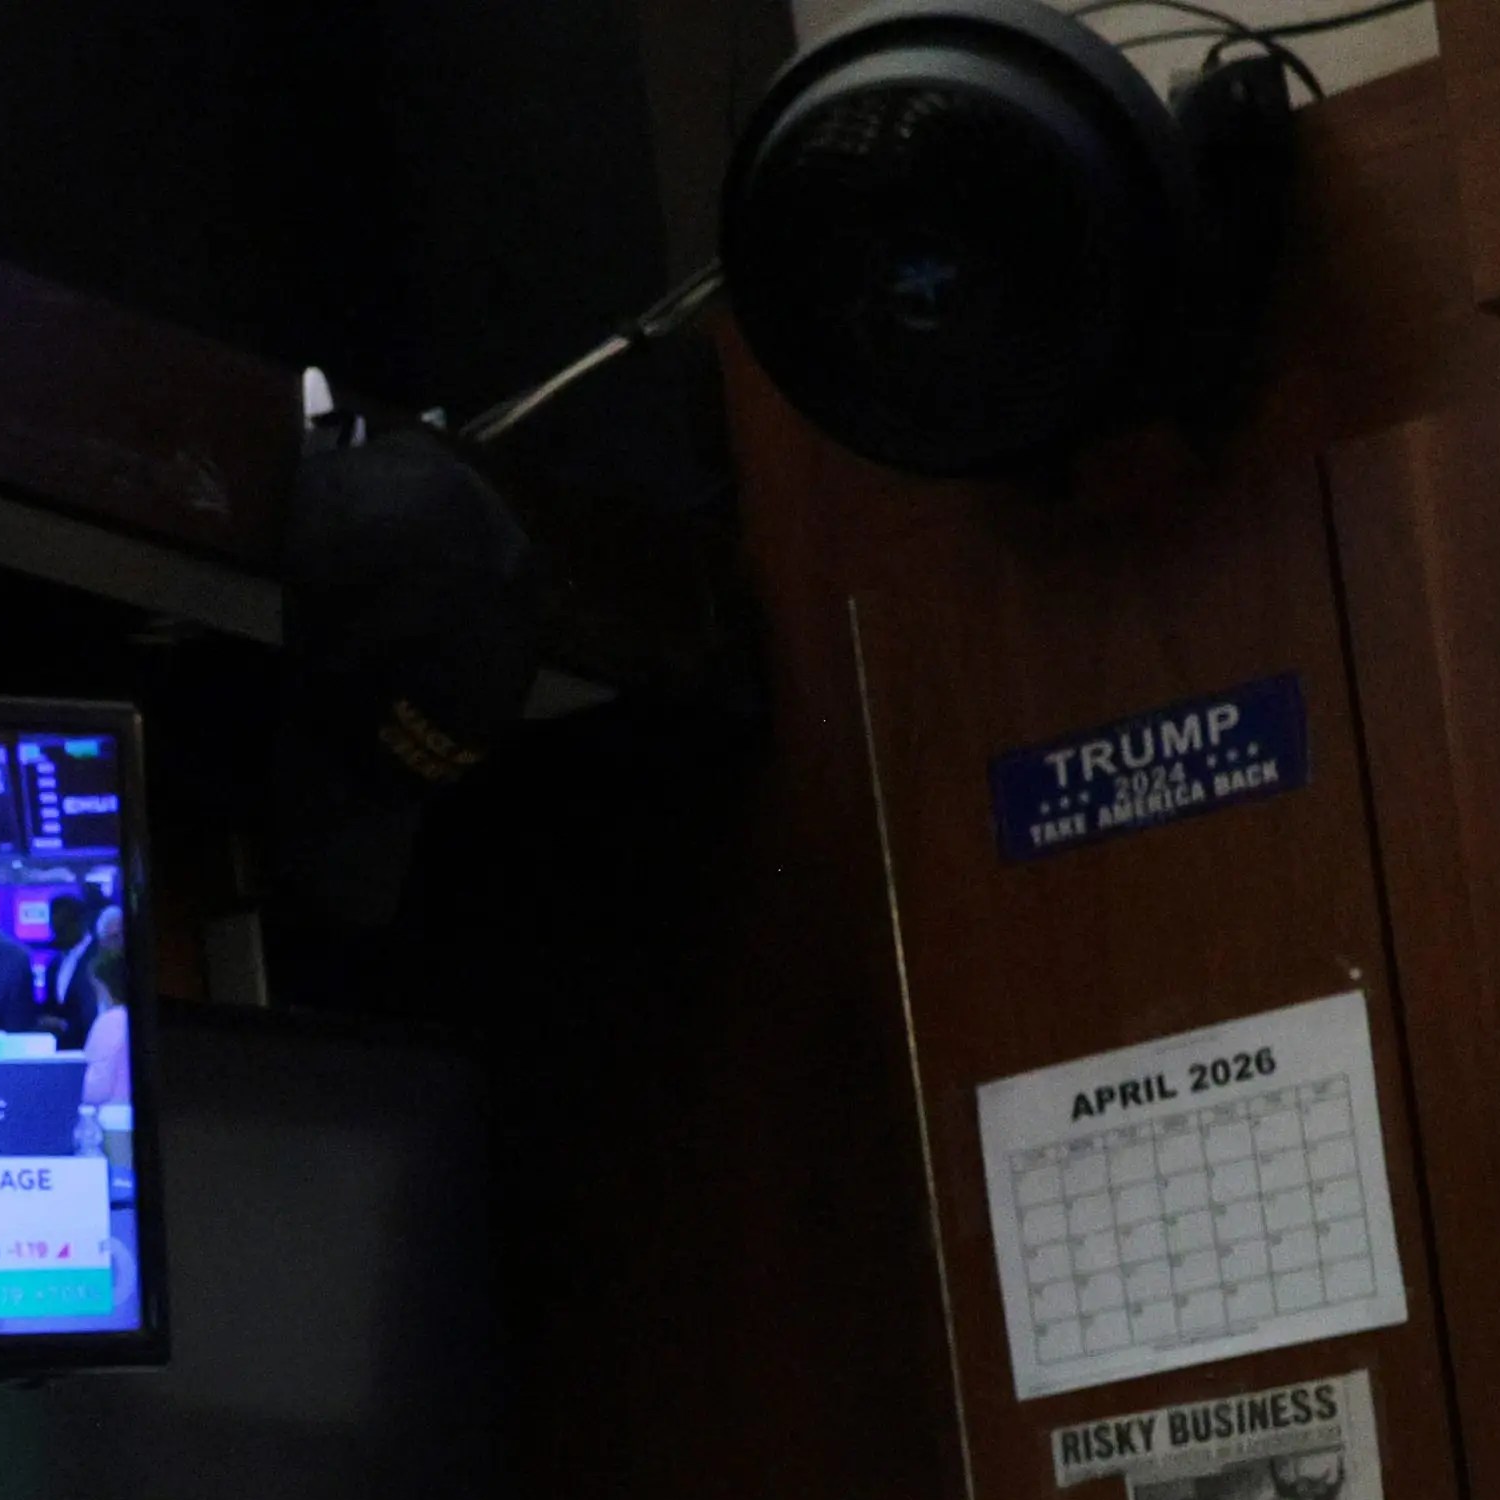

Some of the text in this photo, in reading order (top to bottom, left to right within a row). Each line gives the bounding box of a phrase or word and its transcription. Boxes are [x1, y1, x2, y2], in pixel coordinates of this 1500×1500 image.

[1044, 703, 1240, 788] TRUMP
[1114, 762, 1186, 799] 2024
[1029, 759, 1279, 847] TAKE AMERICA BACK
[1069, 1045, 1277, 1124] APRIL 2026
[1060, 1383, 1339, 1467] RISKY BUSINESS
